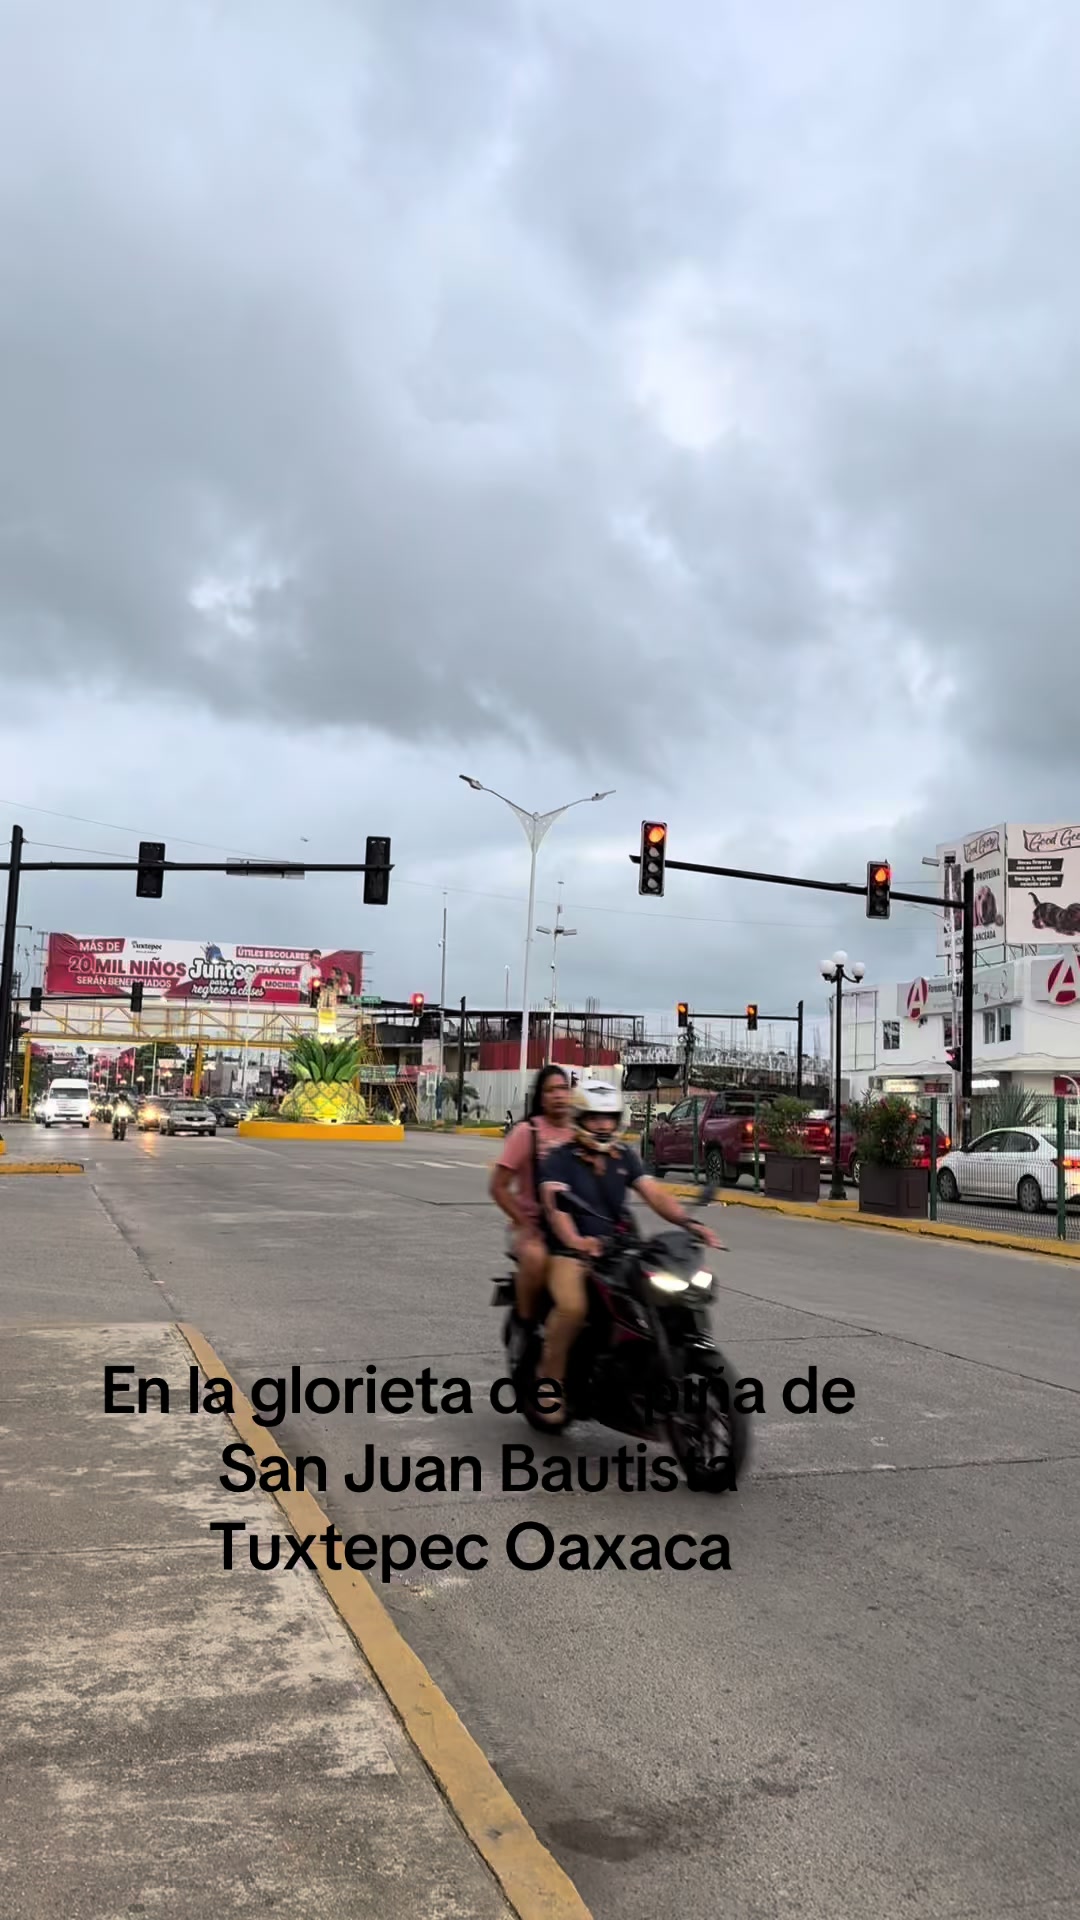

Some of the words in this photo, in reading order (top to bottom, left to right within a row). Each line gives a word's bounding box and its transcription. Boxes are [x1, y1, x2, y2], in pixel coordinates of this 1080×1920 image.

[79, 940, 104, 952] MÁS
[106, 941, 121, 952] DE
[237, 947, 264, 958] ÚTILES
[265, 949, 310, 960] ESCOLARES
[69, 956, 93, 973] 20
[95, 958, 126, 974] MIL
[130, 957, 187, 977] NIÑOS
[189, 958, 255, 980] Juntos
[258, 966, 296, 976] ZAPATOS
[76, 974, 107, 985] SERÁN
[265, 980, 299, 989] MOCHILA
[191, 984, 229, 998] regreso
